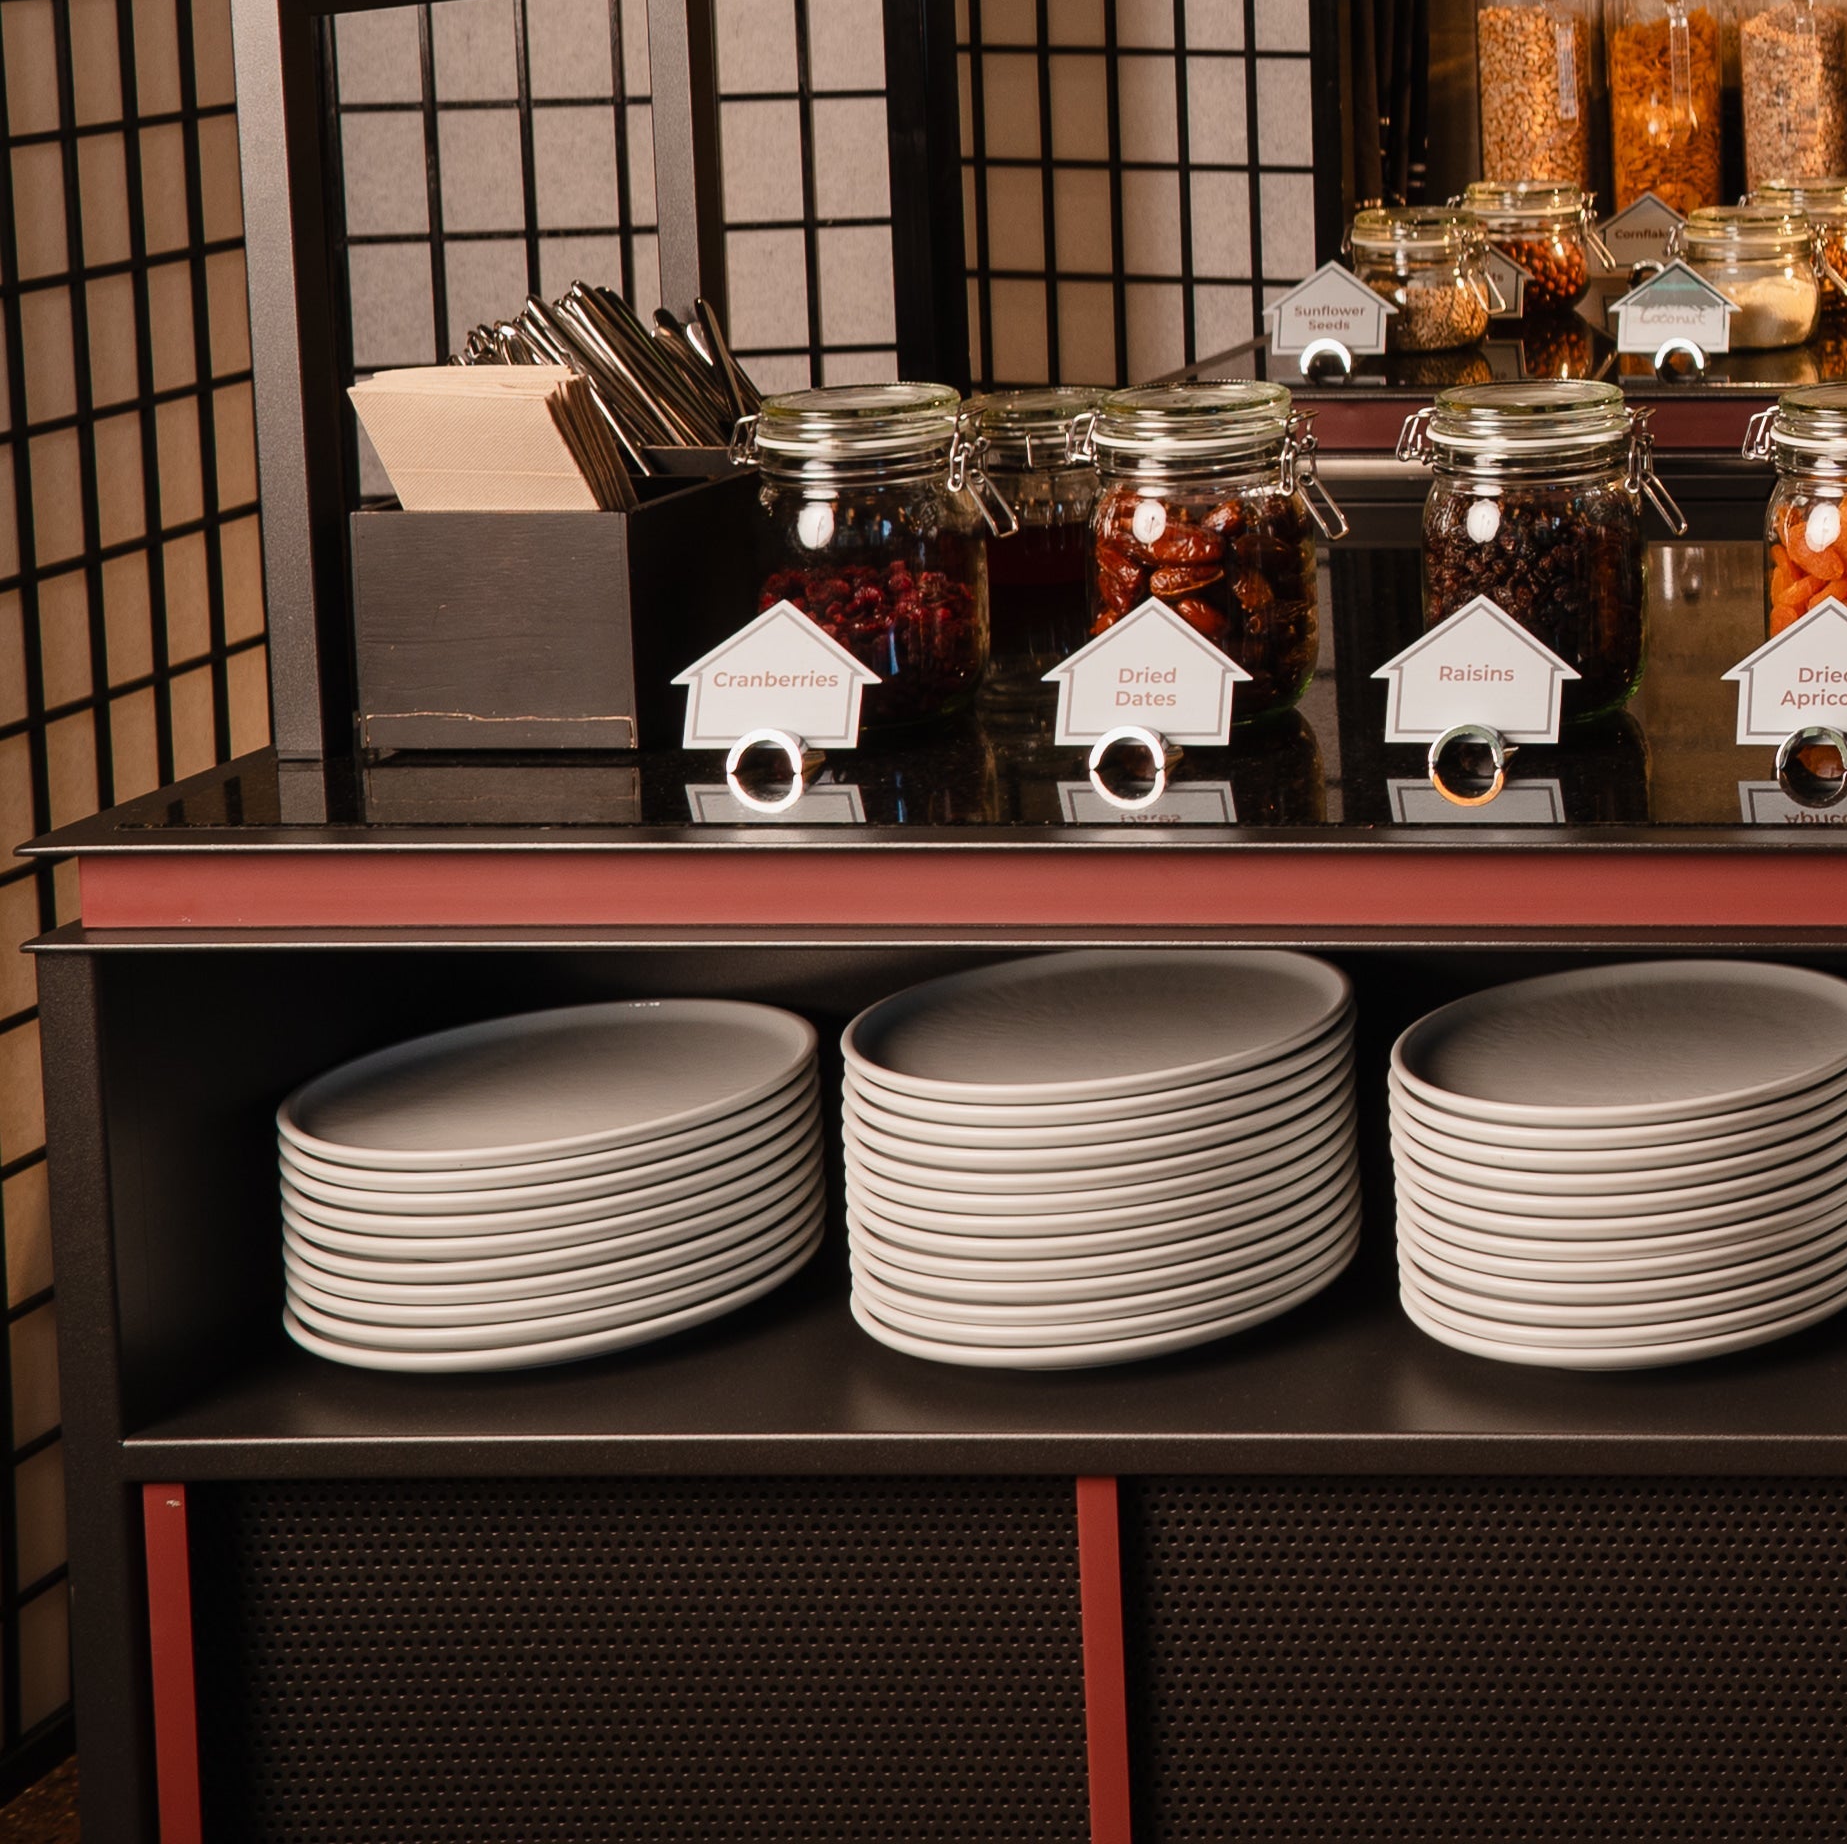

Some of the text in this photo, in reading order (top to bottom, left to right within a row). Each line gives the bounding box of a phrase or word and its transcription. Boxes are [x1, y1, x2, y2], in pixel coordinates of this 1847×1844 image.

[1615, 228, 1668, 240] Cornflak
[1294, 306, 1364, 317] Sunflower
[1308, 320, 1350, 331] Seeds
[713, 670, 839, 690] Cranberries
[1118, 666, 1177, 685] Dried
[1438, 664, 1515, 683] Raisins
[1114, 689, 1177, 708] Dates
